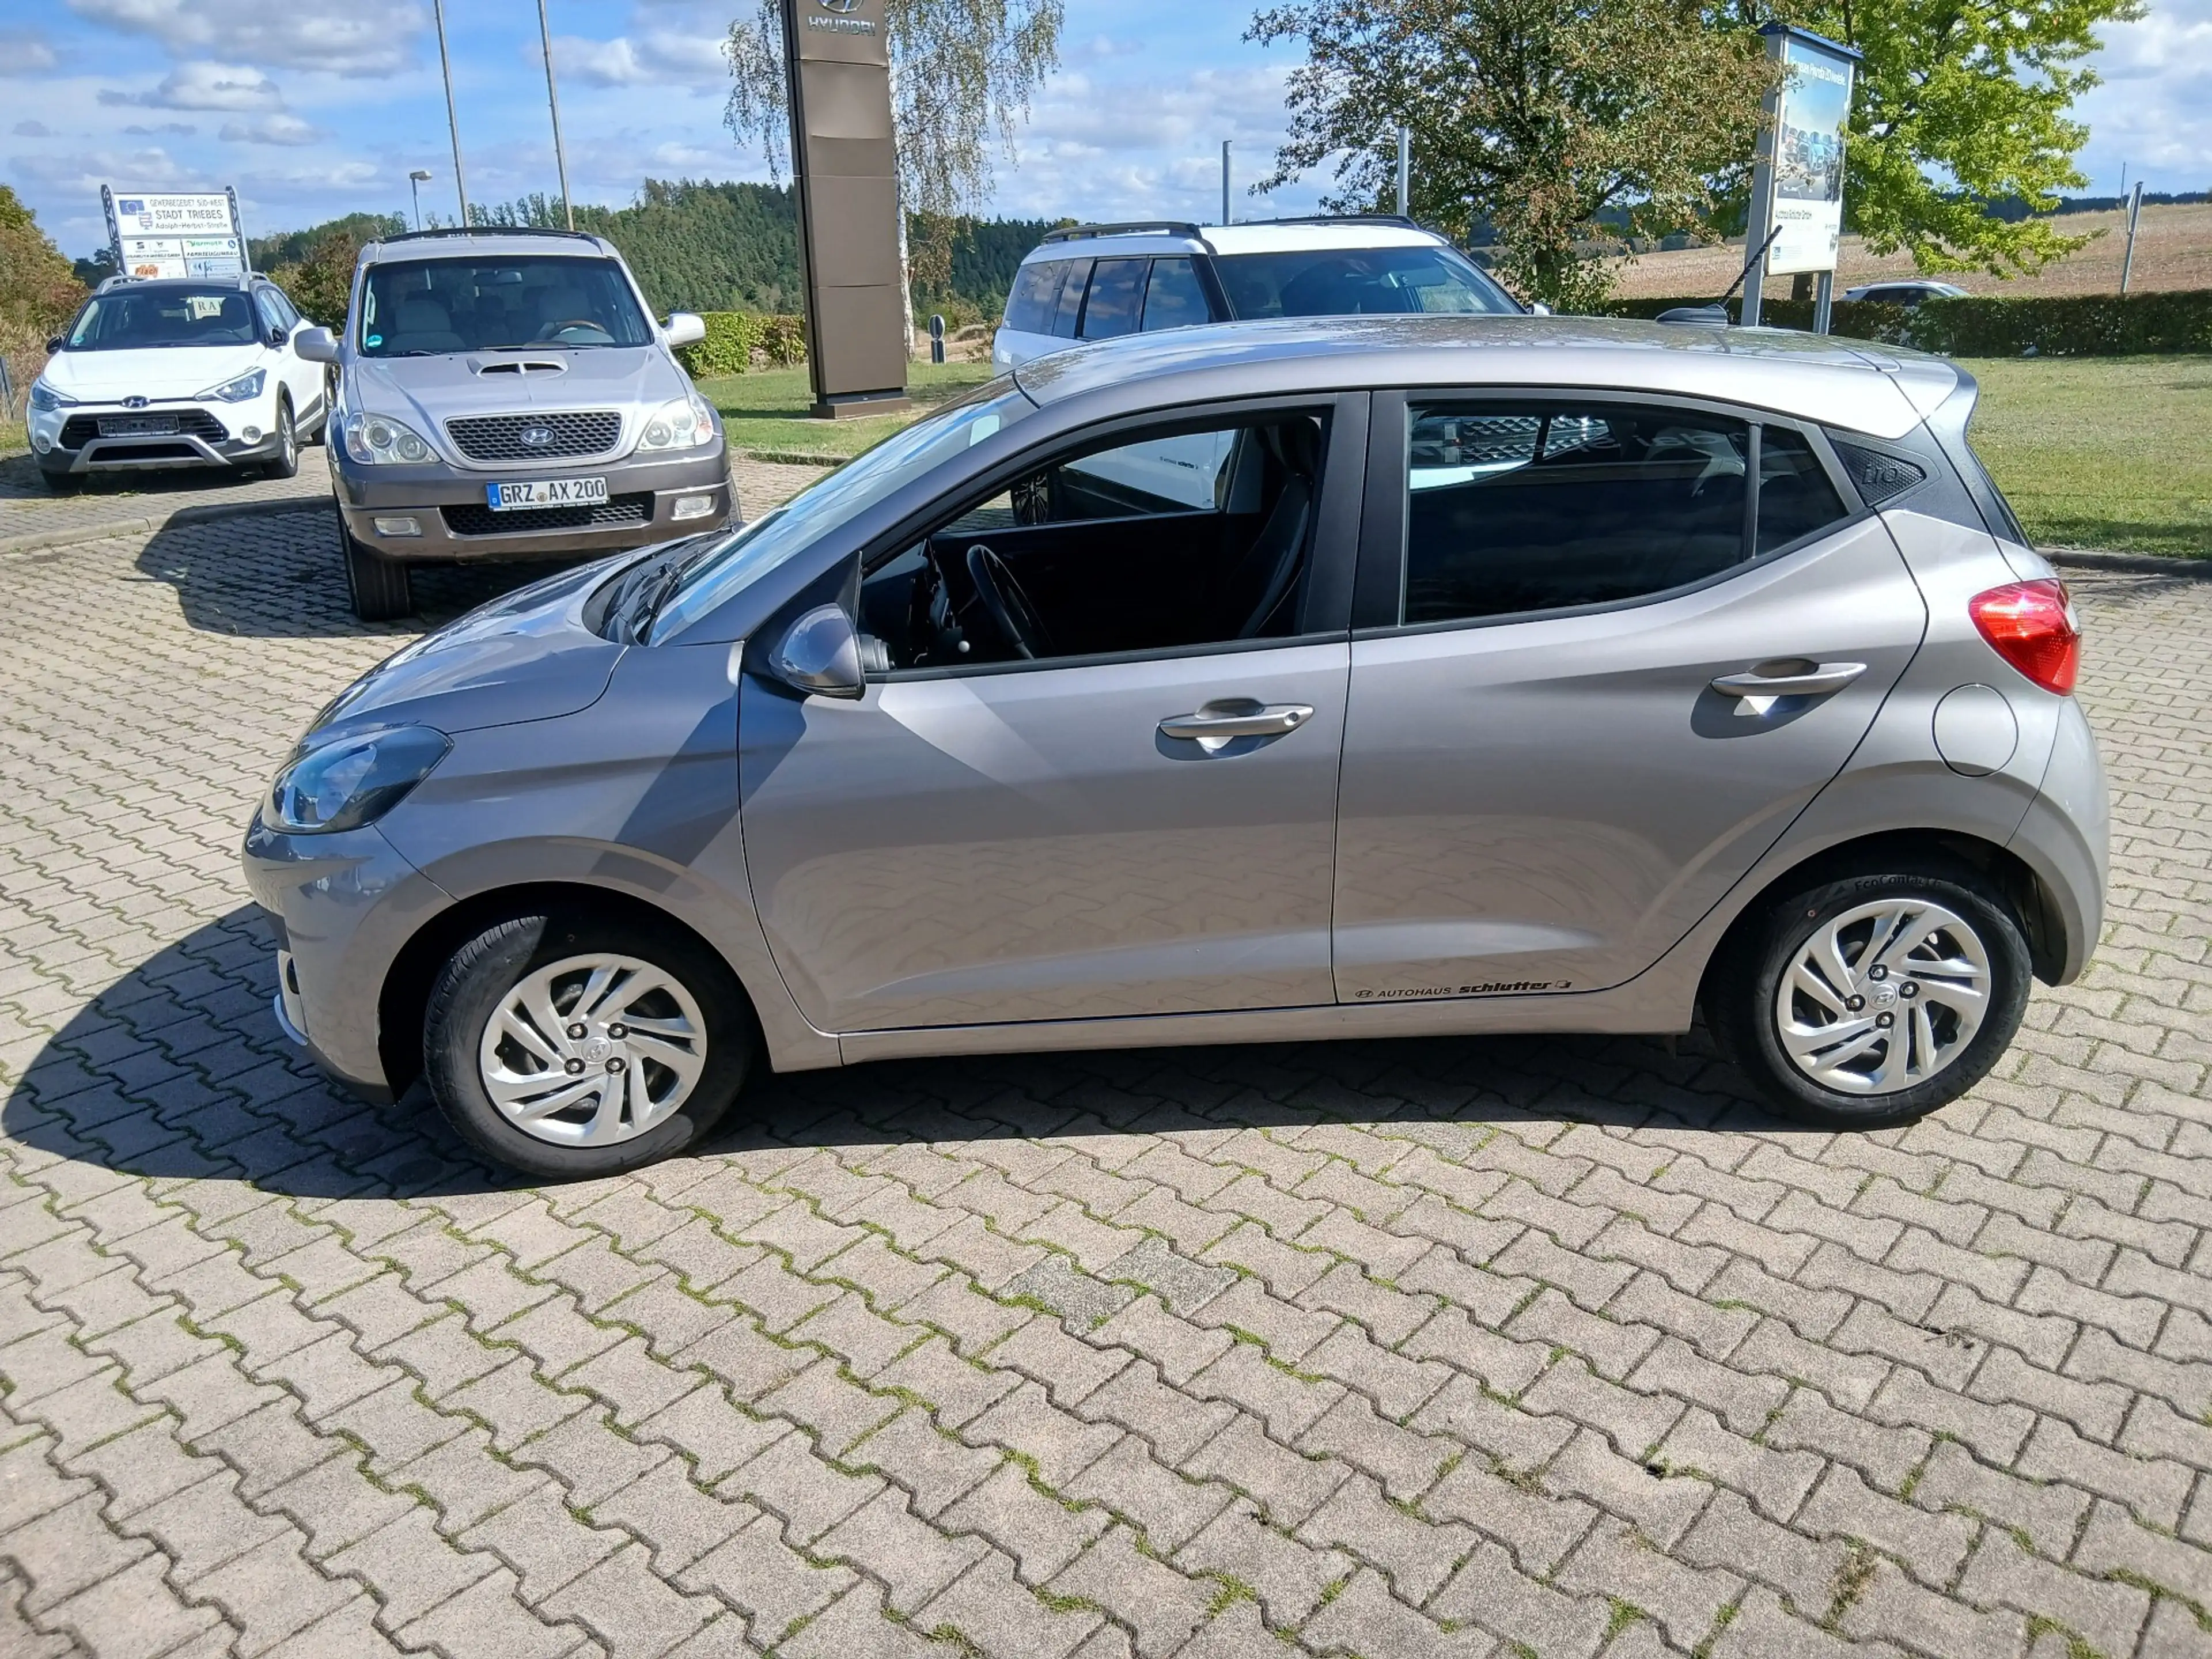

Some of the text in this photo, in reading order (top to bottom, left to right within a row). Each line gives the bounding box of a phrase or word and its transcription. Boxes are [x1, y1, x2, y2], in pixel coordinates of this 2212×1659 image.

[808, 16, 876, 36] HYUNDAI
[155, 210, 223, 219] STADT TRIEBES
[1861, 463, 1898, 484] i10
[500, 484, 535, 504] GRZ
[549, 482, 570, 501] AX
[574, 479, 605, 499] 200
[1377, 980, 1552, 998] AUTOHAUS schlutter
